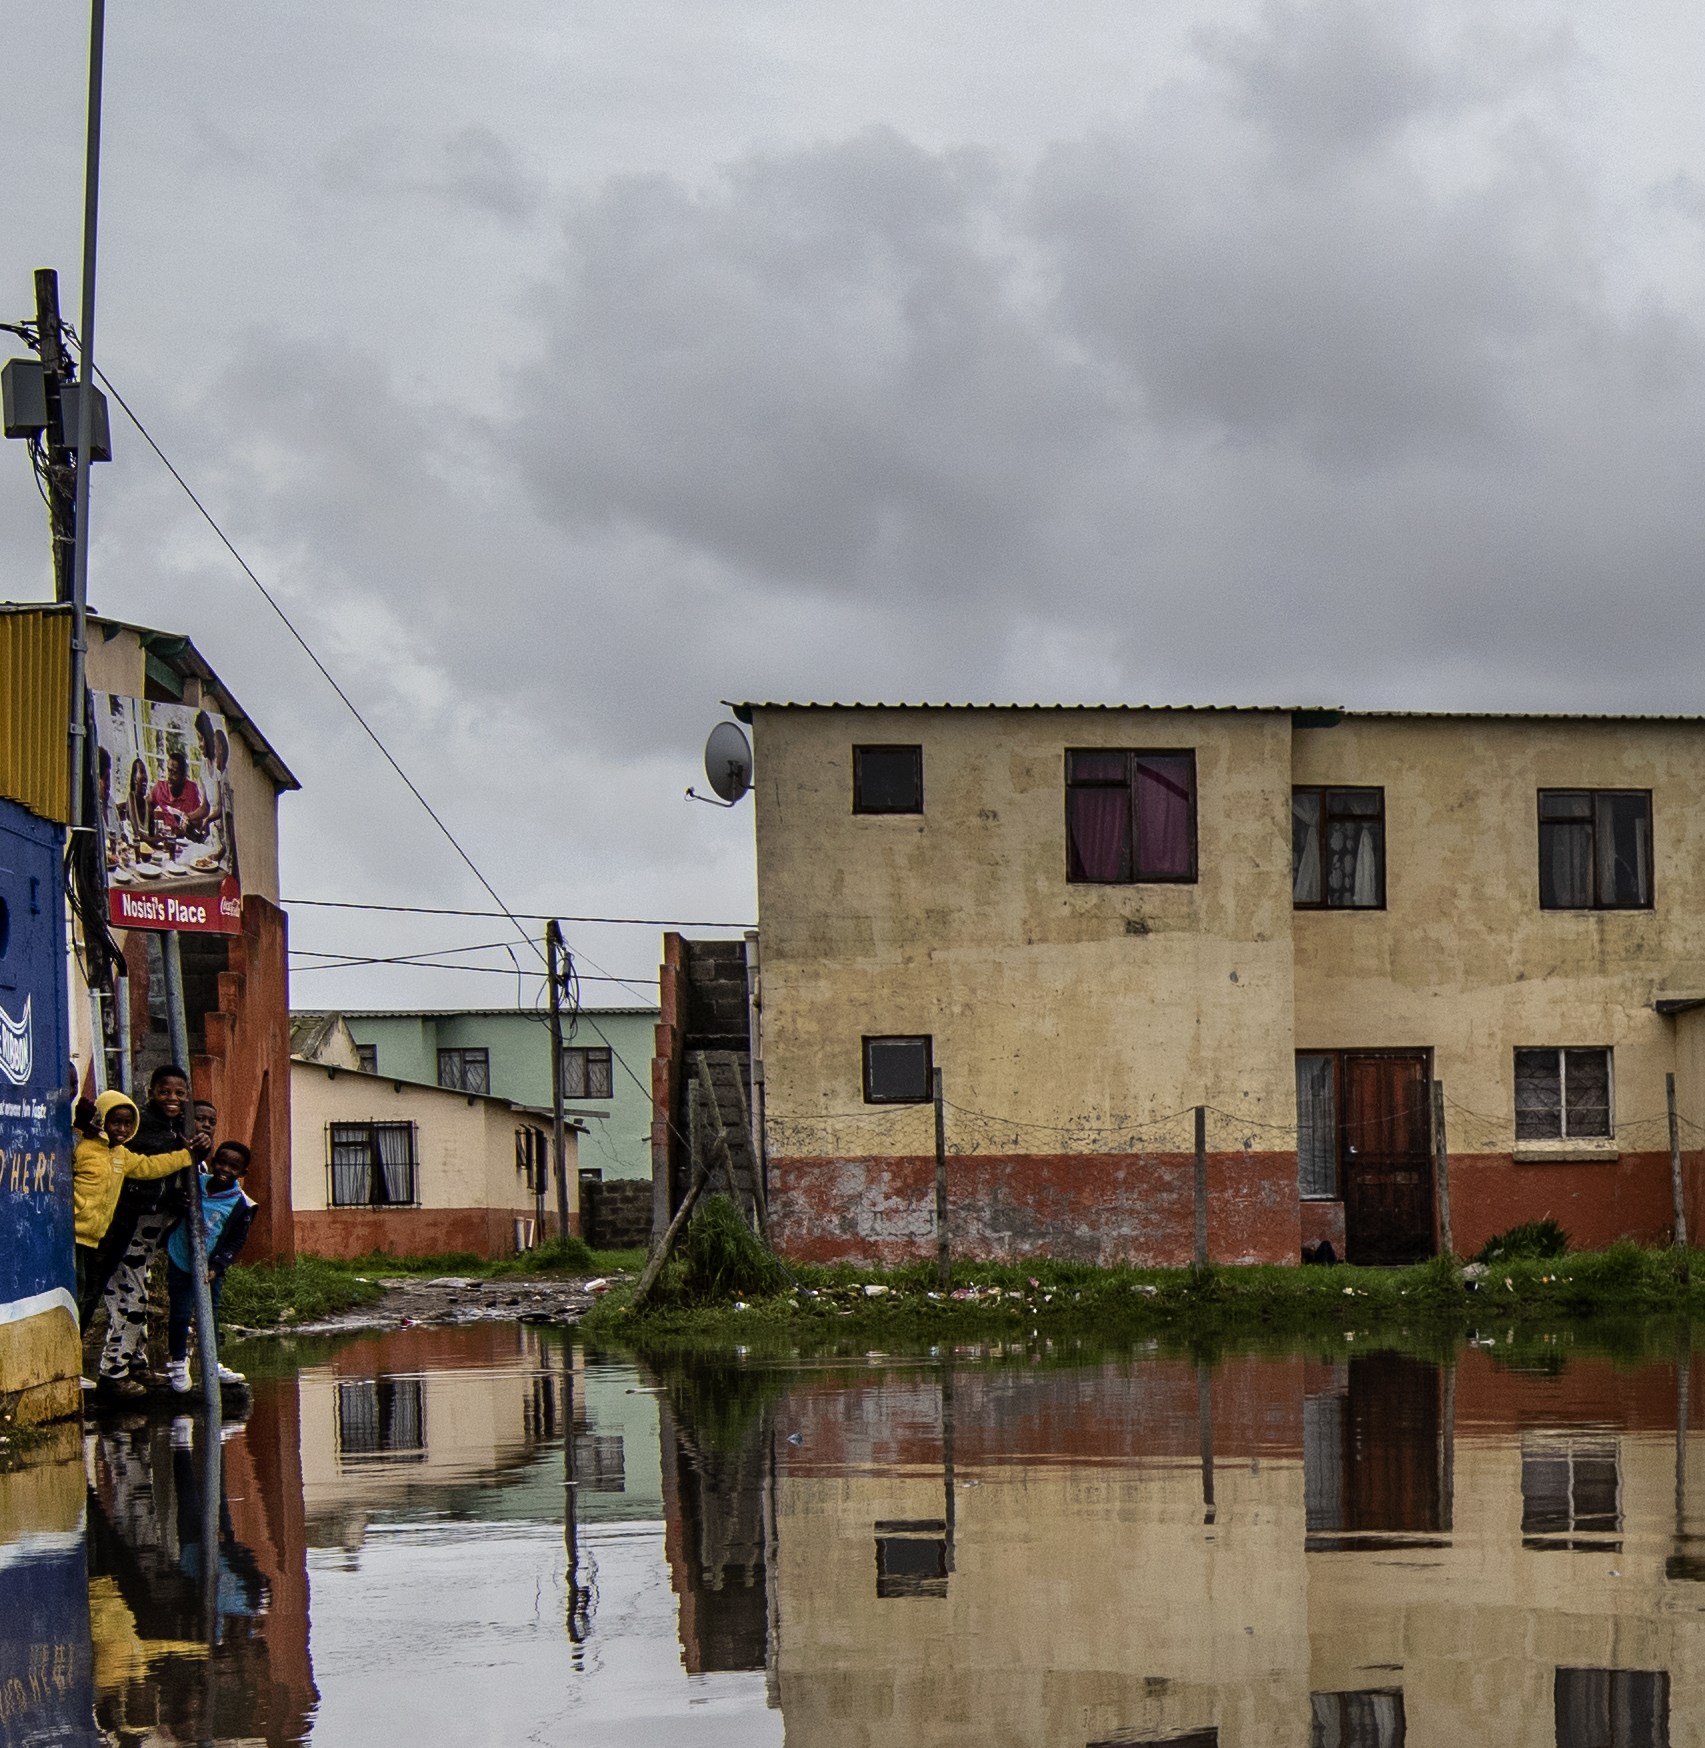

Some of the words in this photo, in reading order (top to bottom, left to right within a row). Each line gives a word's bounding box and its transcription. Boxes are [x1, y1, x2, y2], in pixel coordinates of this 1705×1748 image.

[122, 893, 165, 921] Nosisi's
[167, 898, 206, 923] Place
[2, 1023, 29, 1074] RIBBON
[10, 1152, 56, 1194] HERE
